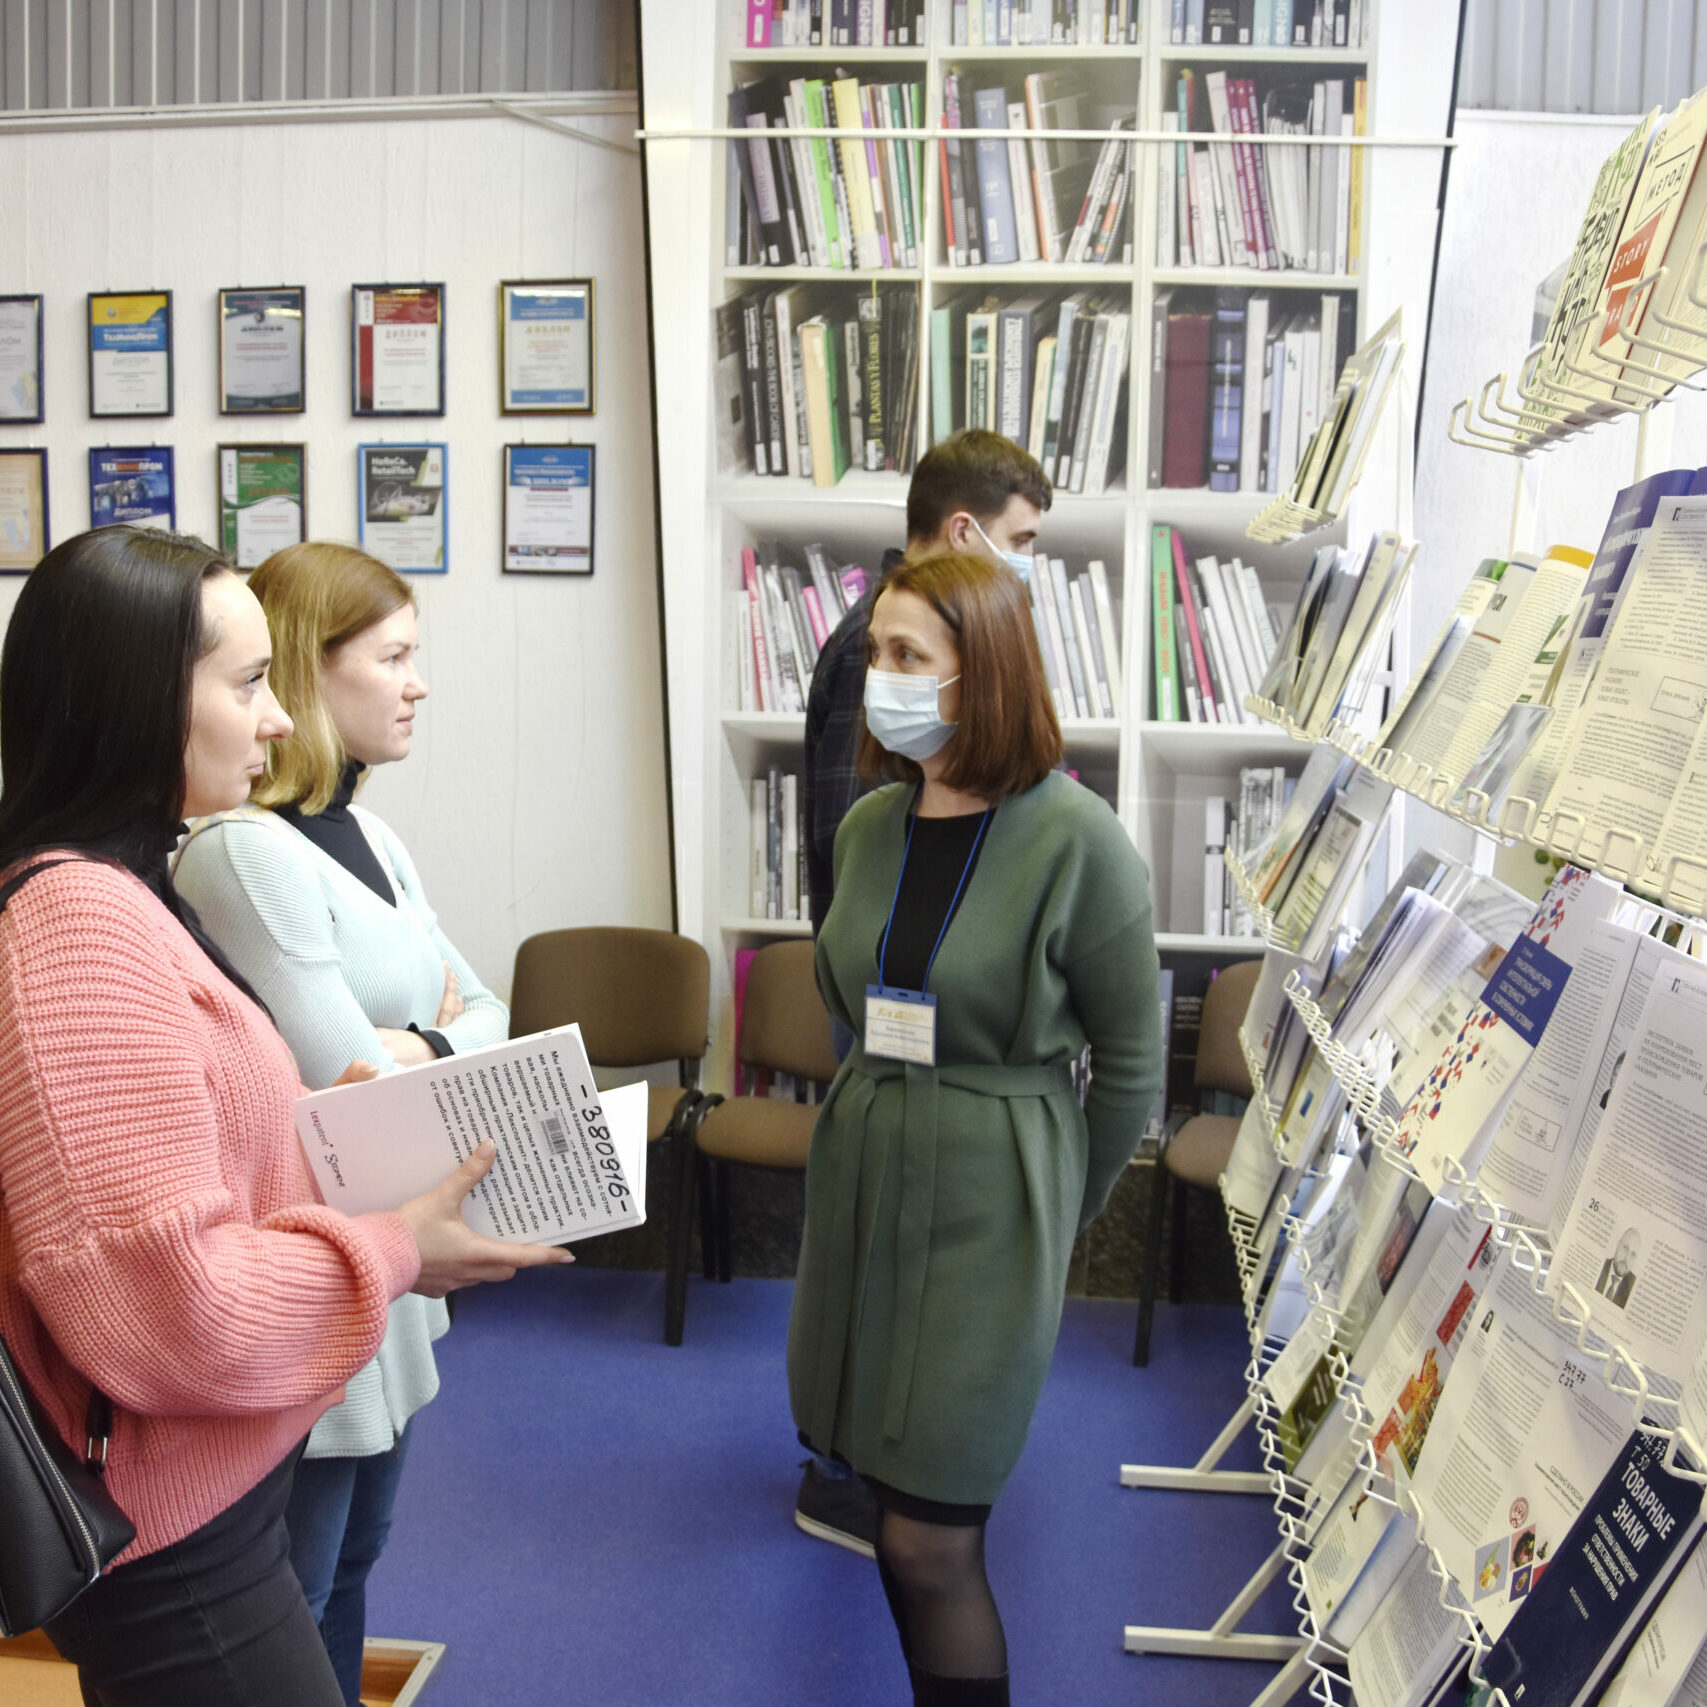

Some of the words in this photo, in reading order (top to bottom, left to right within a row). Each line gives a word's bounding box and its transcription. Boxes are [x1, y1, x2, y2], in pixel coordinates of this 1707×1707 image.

[1646, 163, 1686, 202] МЕТОД
[1613, 238, 1649, 273] STORY
[866, 332, 880, 371] FLORES
[768, 382, 777, 402] BOOK
[769, 403, 778, 412] OF
[868, 379, 881, 423] PLANTAS
[371, 465, 416, 475] RetailTech
[524, 1056, 536, 1074] вая,
[537, 1053, 546, 1065] ми
[549, 1050, 560, 1065] Мы
[429, 1080, 437, 1090] от
[433, 1092, 450, 1123] ошибок
[441, 1077, 451, 1089] об
[541, 1066, 561, 1106] товарных
[554, 1066, 576, 1111] ежедневно
[445, 1090, 462, 1124] основах
[452, 1074, 465, 1095] прав
[461, 1096, 469, 1107] на
[489, 1177, 516, 1235] рассказывает
[465, 1071, 474, 1086] сти
[511, 1203, 528, 1234] защиты
[476, 1068, 498, 1113] обширным
[492, 1113, 518, 1171] практическим
[513, 1171, 530, 1203] опытом
[527, 1209, 541, 1232] обла-
[488, 1065, 509, 1107] Компания
[503, 1107, 529, 1162] «Лекспатент»
[523, 1162, 540, 1195] делится
[536, 1196, 549, 1221] своим
[500, 1063, 519, 1099] товаров,
[514, 1100, 524, 1113] так
[520, 1122, 536, 1148] целых
[531, 1148, 552, 1194] жизненных
[547, 1195, 565, 1230] практик.
[512, 1059, 536, 1108] вершаемый
[548, 1158, 558, 1172] как
[553, 1173, 574, 1216] отдельных
[570, 1112, 603, 1184] взаимодействуем
[563, 1165, 579, 1195] влияют
[571, 1150, 586, 1178] всегда
[575, 1196, 582, 1206] на
[581, 1178, 597, 1210] осозна-
[599, 1191, 613, 1217] сотня-
[578, 1207, 588, 1221] со-
[1622, 1461, 1675, 1540] ТОВАРНЫЕ
[1612, 1498, 1649, 1552] ЗНАКИ
[1591, 1533, 1625, 1586] ОТВЕТСТВЕННОСТИ
[1594, 1513, 1615, 1546] ПРОБЛЕМЫ
[1611, 1541, 1638, 1583] ПРИМЕНЕНИЯ
[1582, 1542, 1590, 1554] ЗА
[1605, 1580, 1618, 1600] ПРАВ
